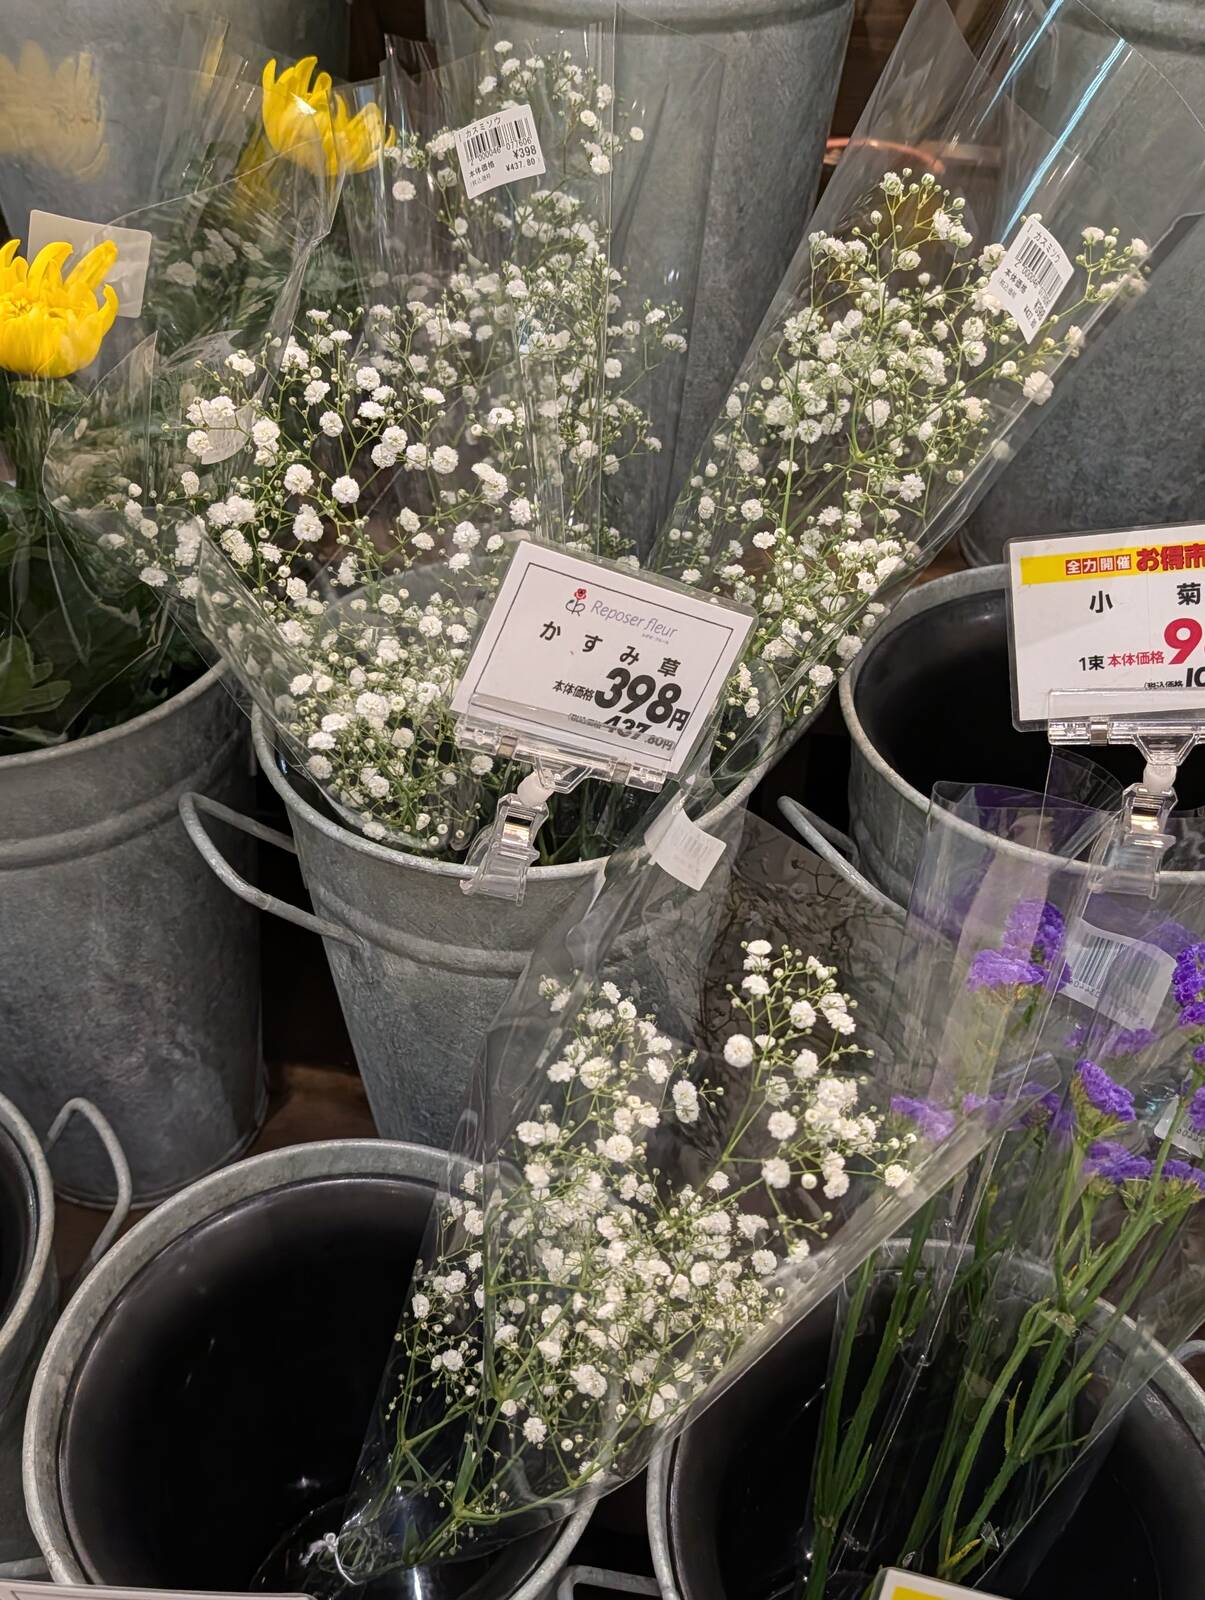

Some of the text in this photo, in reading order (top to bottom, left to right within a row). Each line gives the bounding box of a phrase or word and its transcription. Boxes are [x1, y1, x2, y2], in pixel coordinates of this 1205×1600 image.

[466, 116, 501, 138] カスミソウ
[512, 145, 537, 160] ¥398
[1066, 554, 1131, 575] 全力開催
[591, 600, 678, 638] Reposer fleur
[1079, 655, 1105, 671] 1束
[1107, 651, 1165, 668] 本体価格
[553, 680, 596, 701] 本体価格
